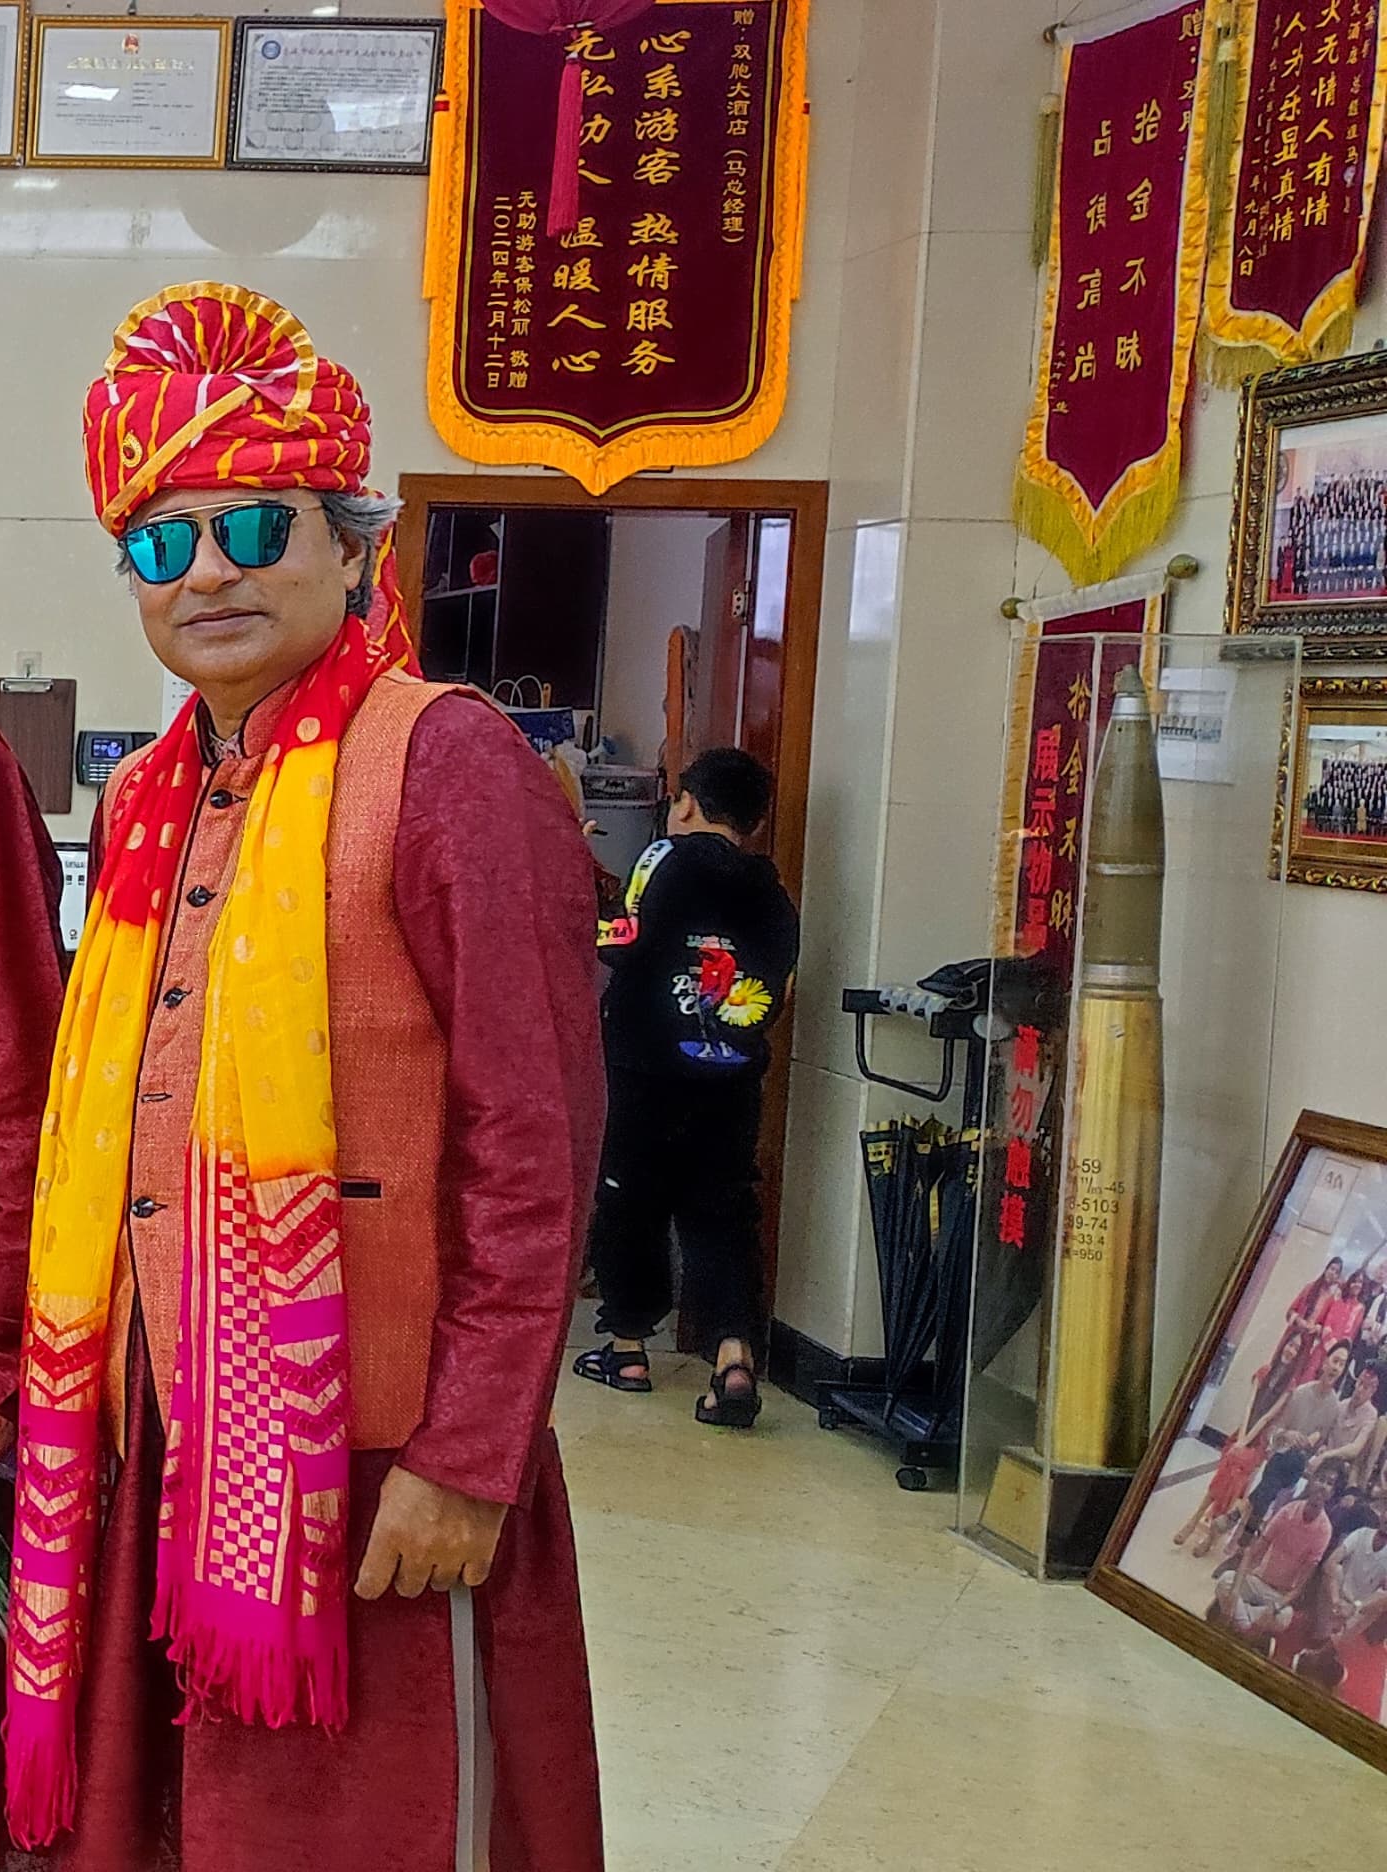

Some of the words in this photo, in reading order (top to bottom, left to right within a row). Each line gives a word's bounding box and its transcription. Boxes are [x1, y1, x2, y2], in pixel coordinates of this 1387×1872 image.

[633, 29, 693, 186] 心系游客
[547, 216, 609, 373] 温暖人心
[621, 213, 680, 376] 热情服务
[1115, 99, 1163, 372] 拾金不昧
